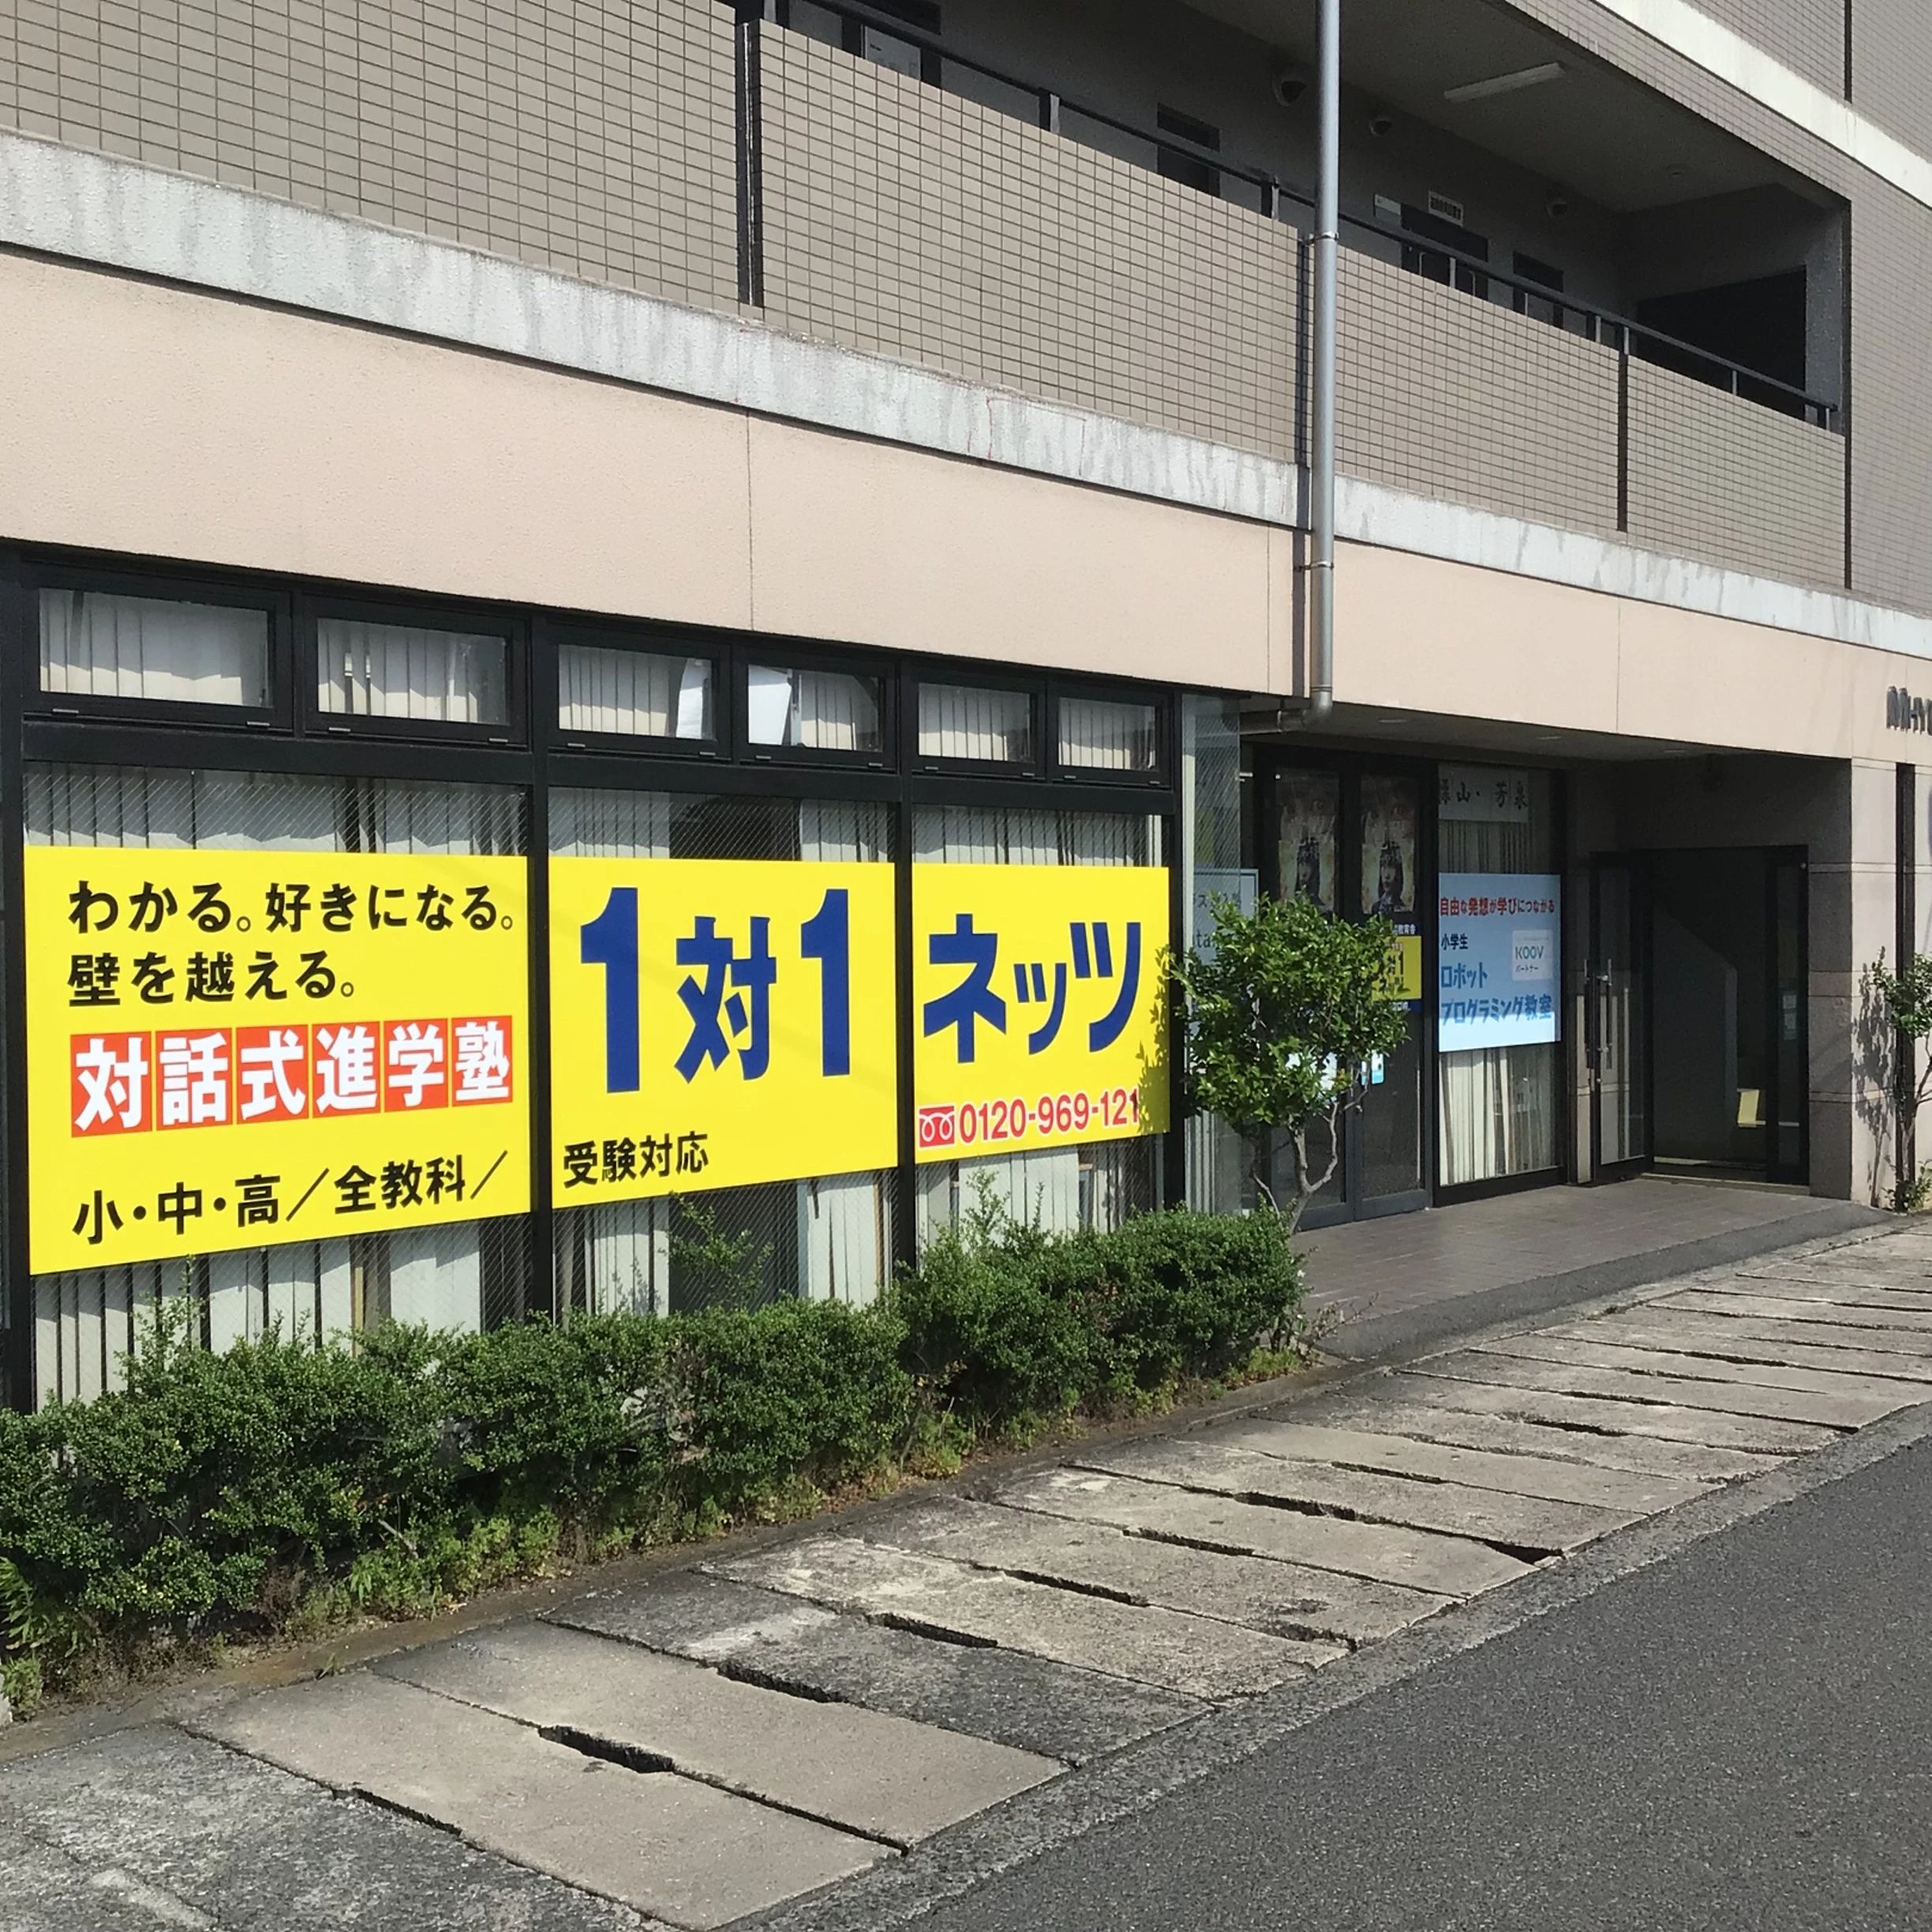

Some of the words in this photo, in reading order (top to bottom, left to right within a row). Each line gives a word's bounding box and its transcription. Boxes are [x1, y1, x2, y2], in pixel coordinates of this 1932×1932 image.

[69, 880, 512, 934] わかる。好きになる。
[1440, 897, 1555, 916] 自由な発想が学びにつながる
[1441, 933, 1469, 950] 小学生
[1515, 945, 1544, 960] KOOV
[68, 950, 354, 1007] 壁を越える。
[580, 887, 850, 1093] 1対1
[923, 913, 1141, 1063] ネッツ
[1441, 961, 1488, 989] ロボット
[1441, 994, 1552, 1025] プログラミング教室
[75, 1020, 510, 1130] 対話式進学塾
[959, 1088, 1138, 1144] 0120-969-121
[563, 1132, 709, 1188] 受験対応
